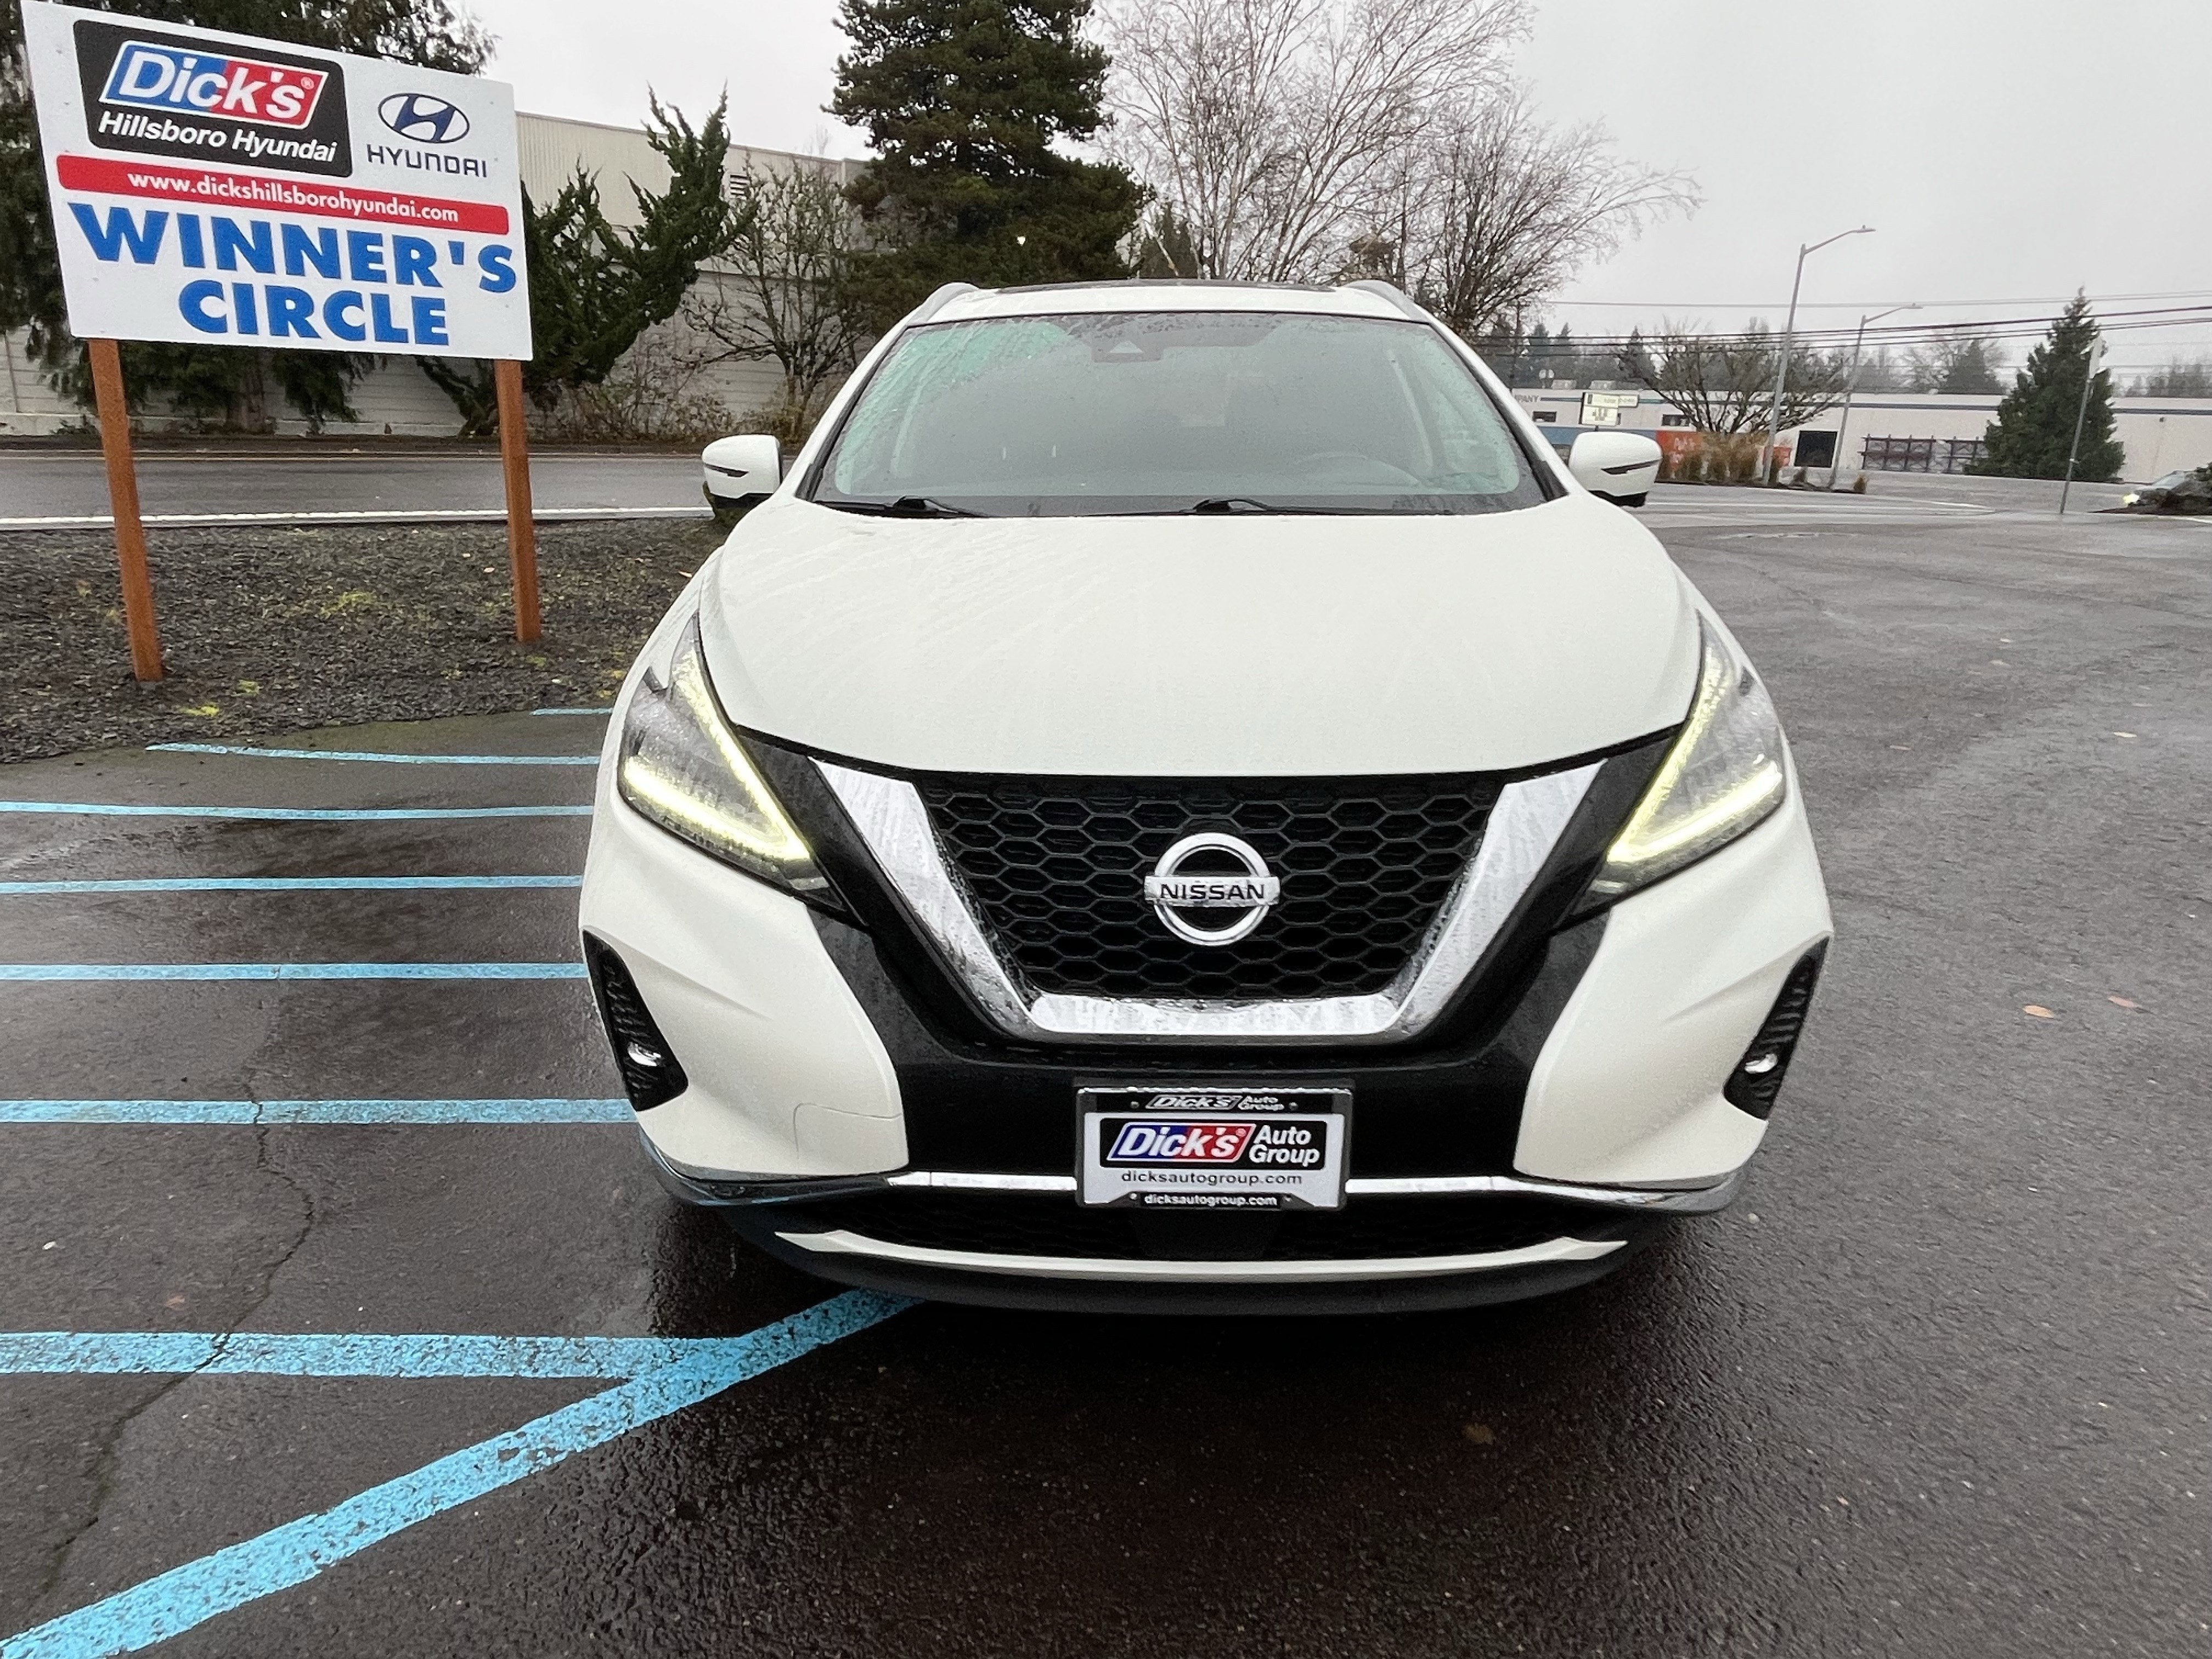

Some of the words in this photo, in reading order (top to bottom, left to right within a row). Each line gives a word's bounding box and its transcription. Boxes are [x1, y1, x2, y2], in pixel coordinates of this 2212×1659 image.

[98, 112, 227, 148] Hillsboro
[233, 129, 337, 162] Hyundai
[367, 144, 487, 178] HYUNDAI
[127, 170, 459, 223] www.dickshillsborohyundai.com
[69, 203, 516, 293] WINNER'S
[178, 280, 449, 346] CIRCLE
[1161, 883, 1264, 900] NISSAN
[1254, 1125, 1311, 1145] Auto
[1249, 1144, 1320, 1166] Group
[1121, 1170, 1302, 1186] dicksautogroup.com
[1144, 1194, 1277, 1207] dicksautogroup.com
